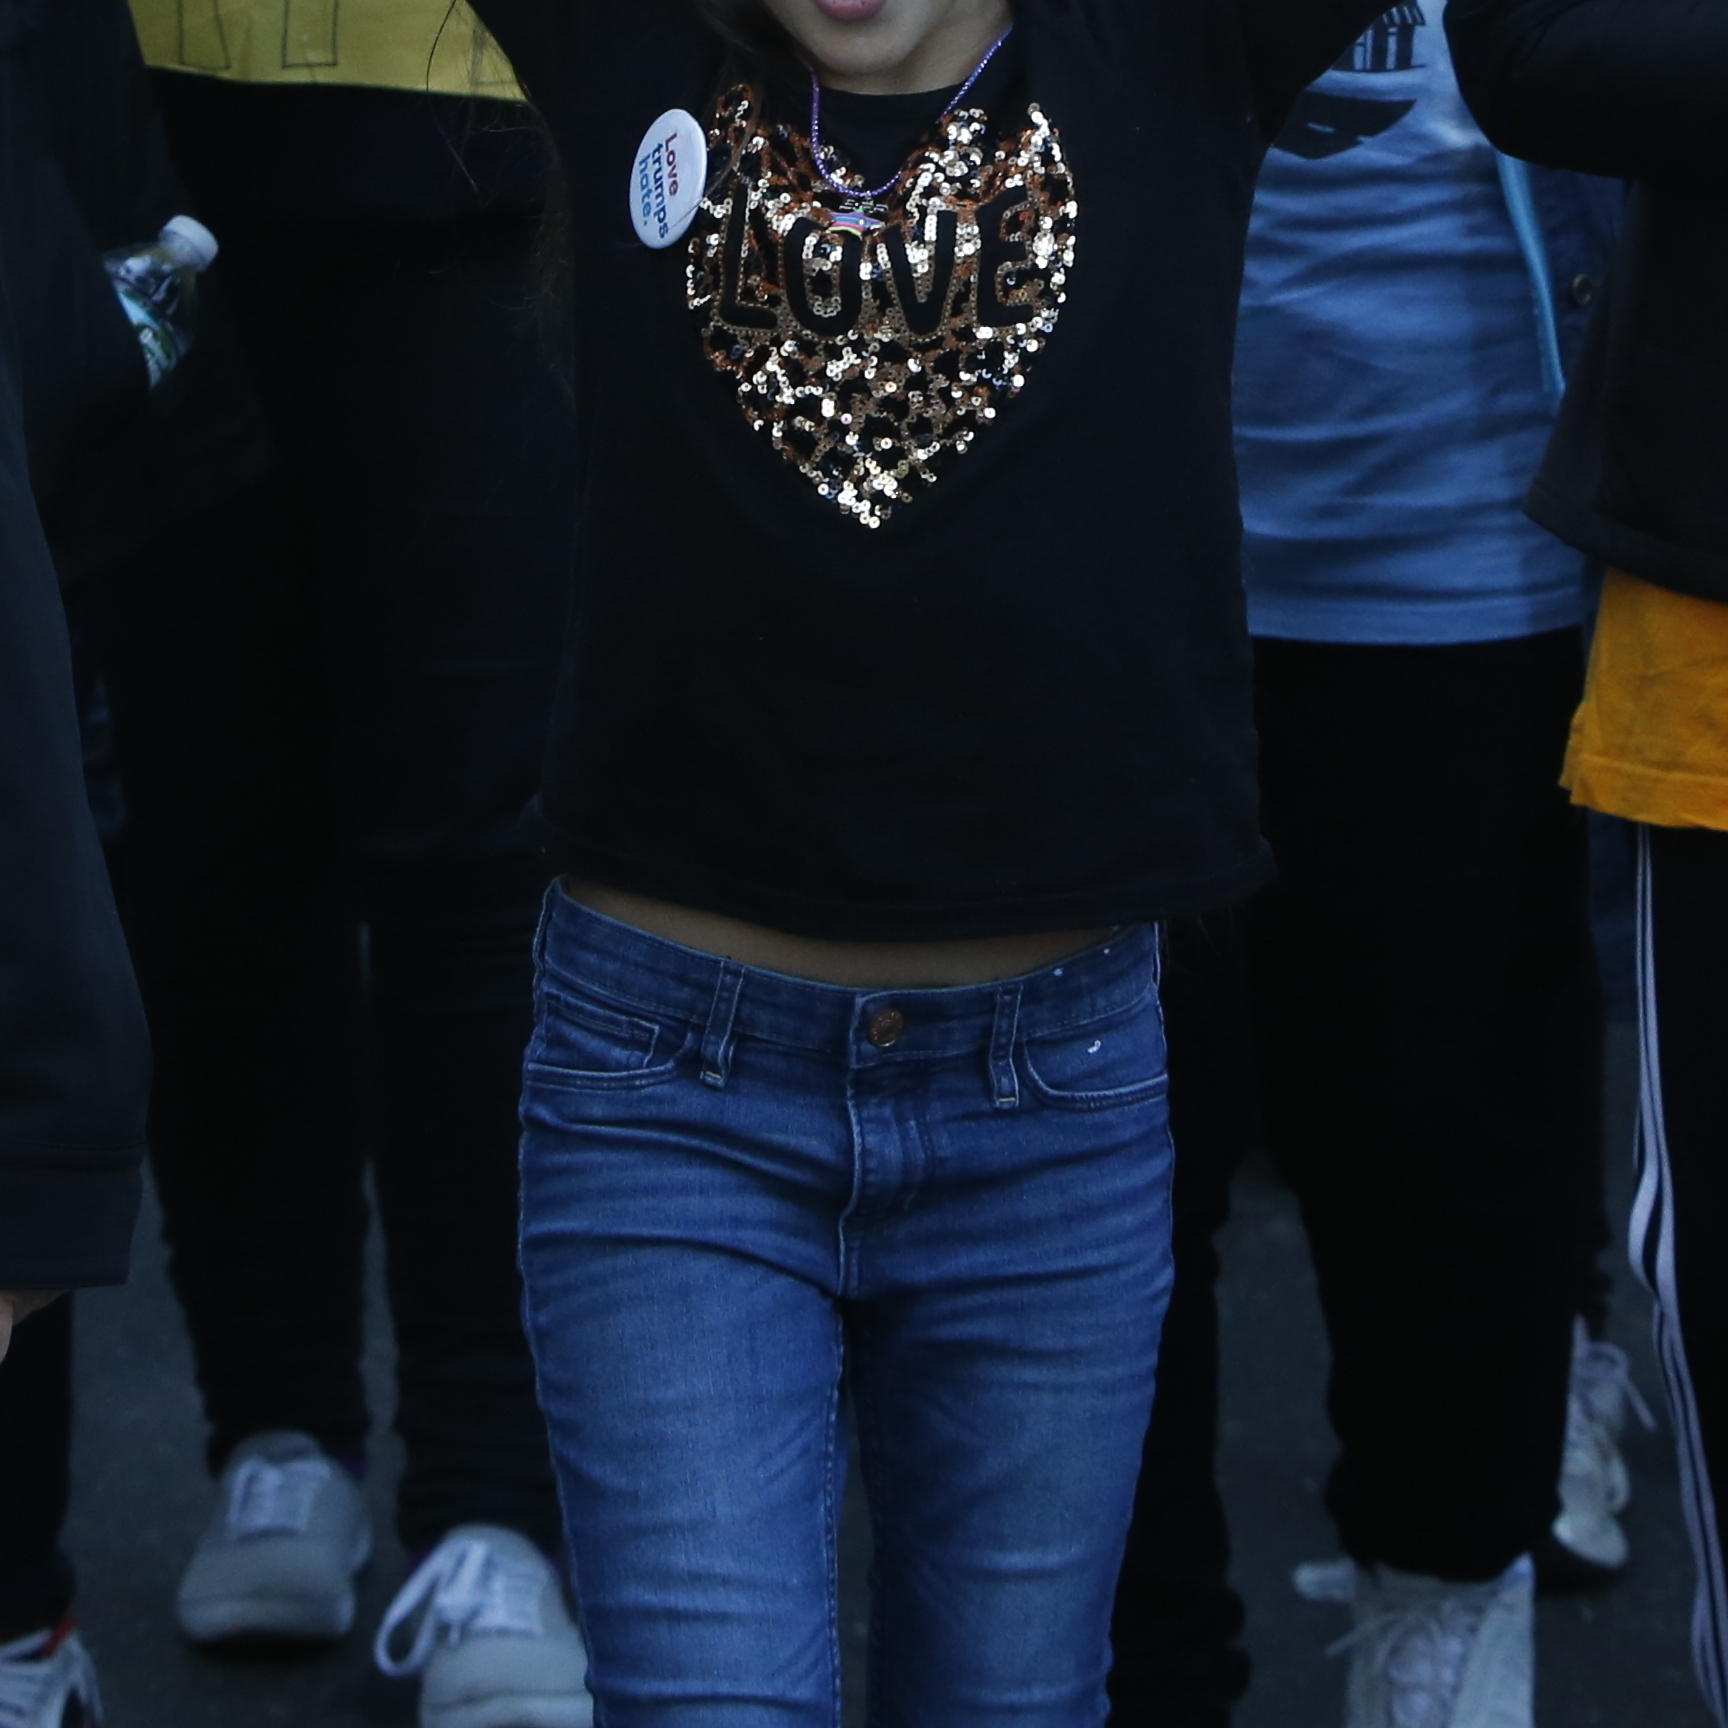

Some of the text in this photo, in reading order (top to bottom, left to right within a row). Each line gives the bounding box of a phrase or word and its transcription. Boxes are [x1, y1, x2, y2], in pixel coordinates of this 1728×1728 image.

[638, 152, 653, 226] hate.
[651, 142, 669, 239] trumps
[665, 132, 678, 196] Love
[720, 179, 1042, 337] LOVE
